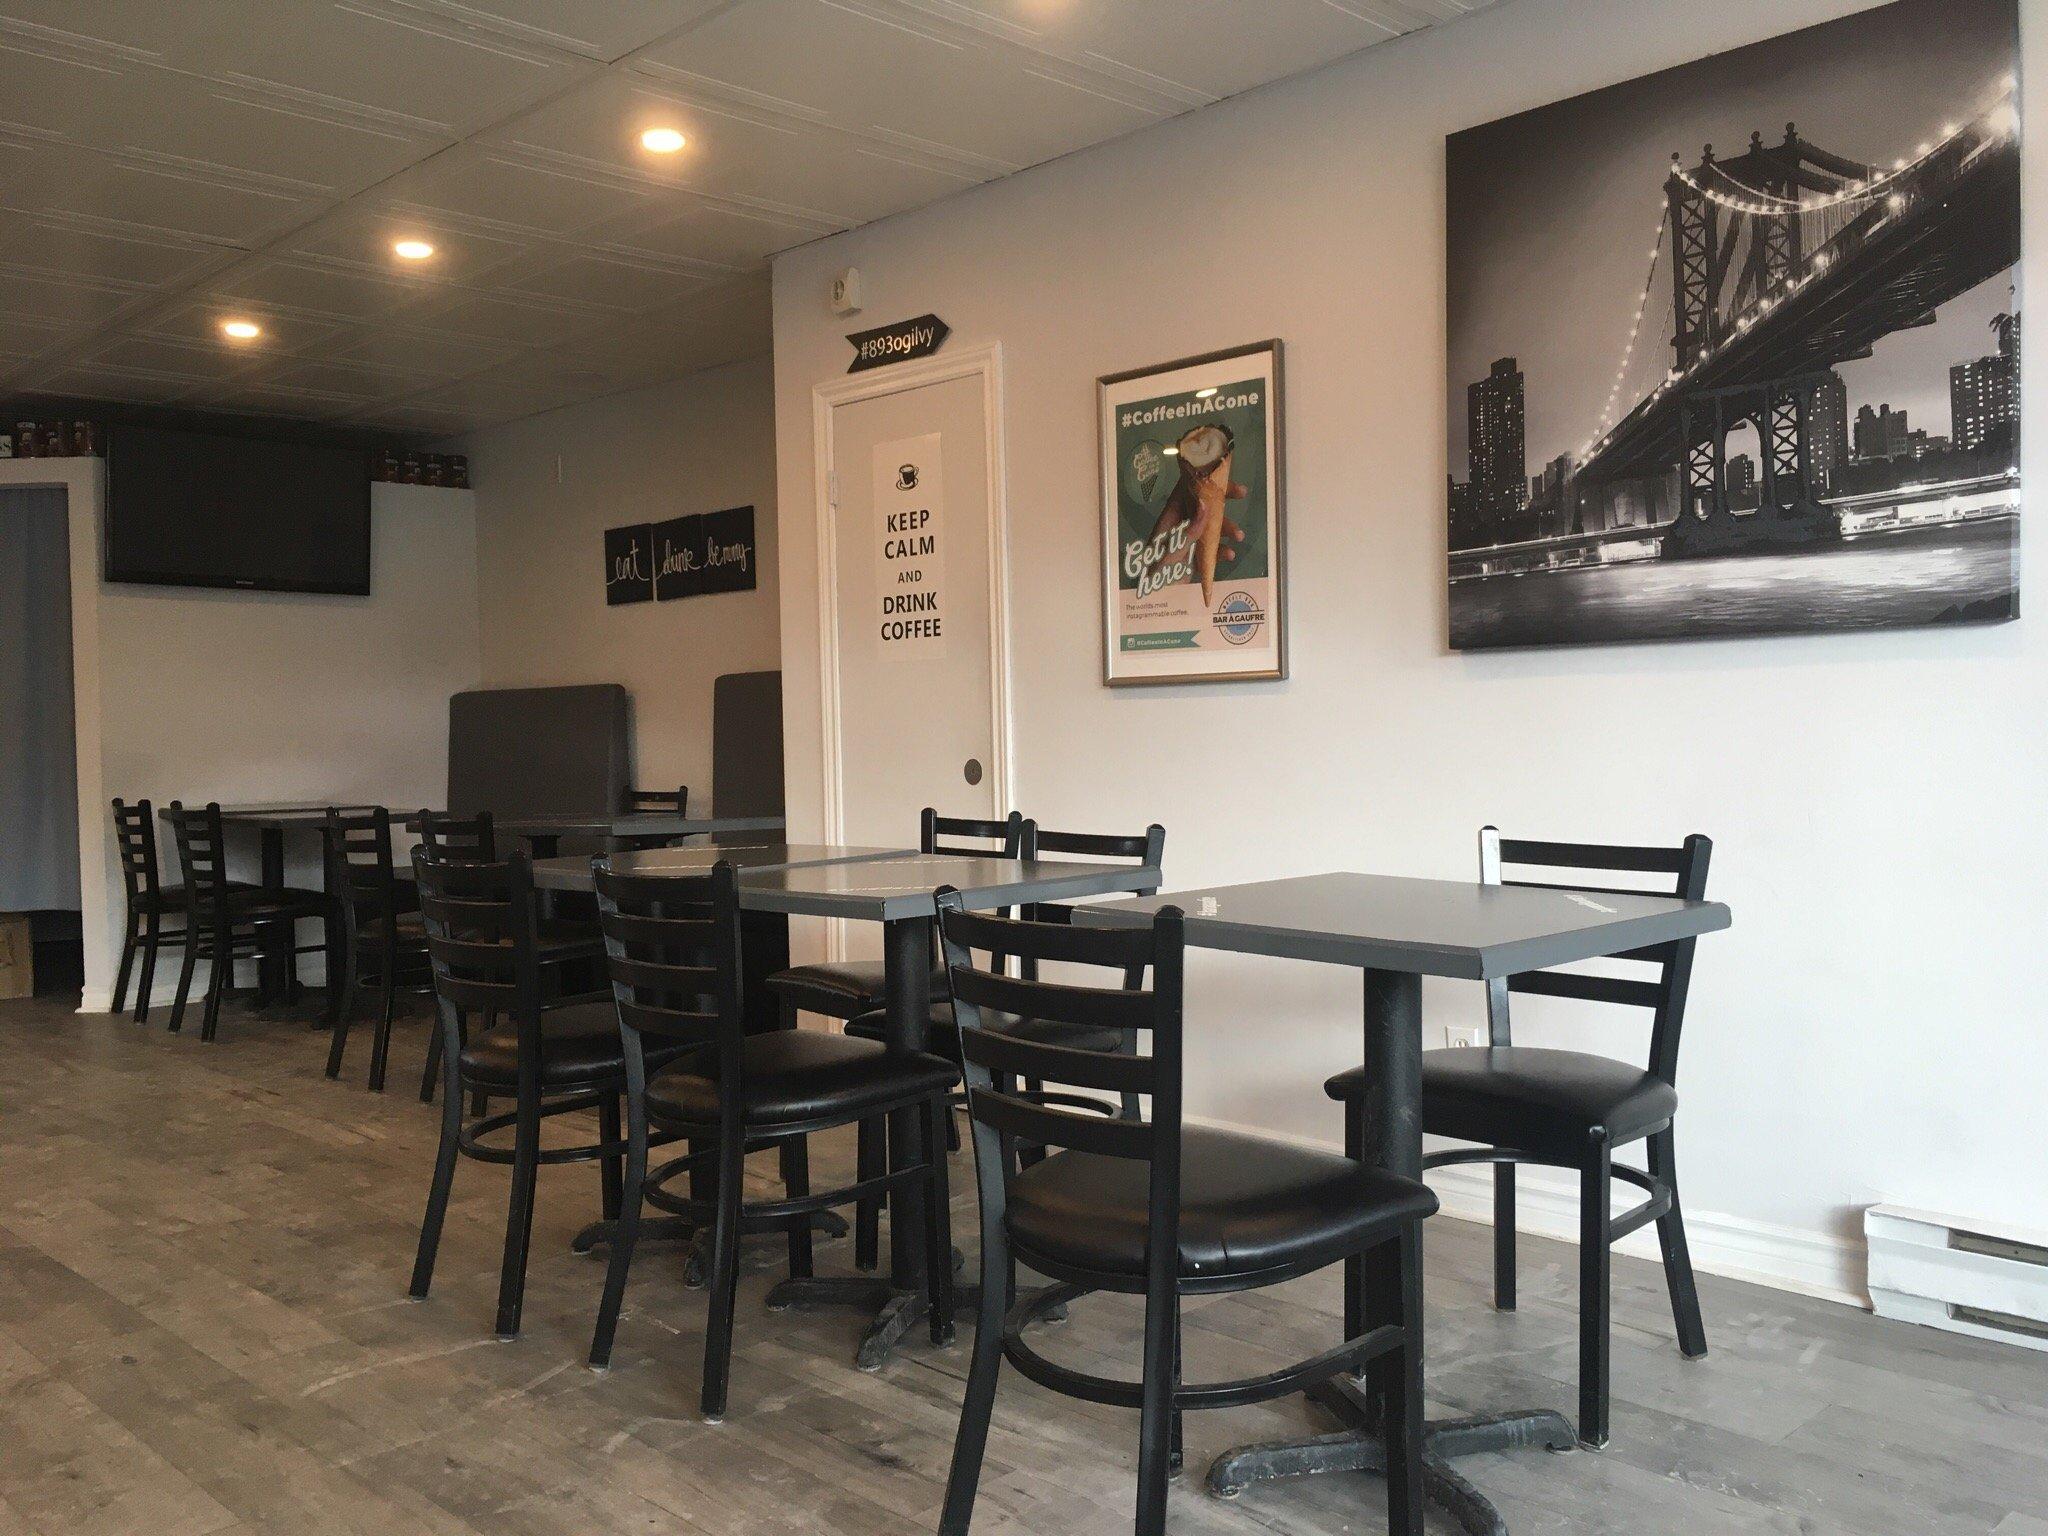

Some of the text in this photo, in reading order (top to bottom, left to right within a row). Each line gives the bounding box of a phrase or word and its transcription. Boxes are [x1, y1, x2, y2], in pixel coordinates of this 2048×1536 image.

[861, 326, 935, 361] #893ogilvy
[1121, 392, 1259, 427] #CoffeeInACone
[887, 509, 930, 534] KEEP
[884, 535, 935, 560] CALM
[1124, 519, 1191, 578] Get it
[606, 538, 651, 586] eat
[1136, 542, 1196, 599] here!
[897, 569, 923, 584] AND
[883, 591, 938, 615] DRINK
[881, 618, 942, 641] COFFEE
[1212, 616, 1228, 624] BAR
[1234, 613, 1265, 623] GAUFRE
